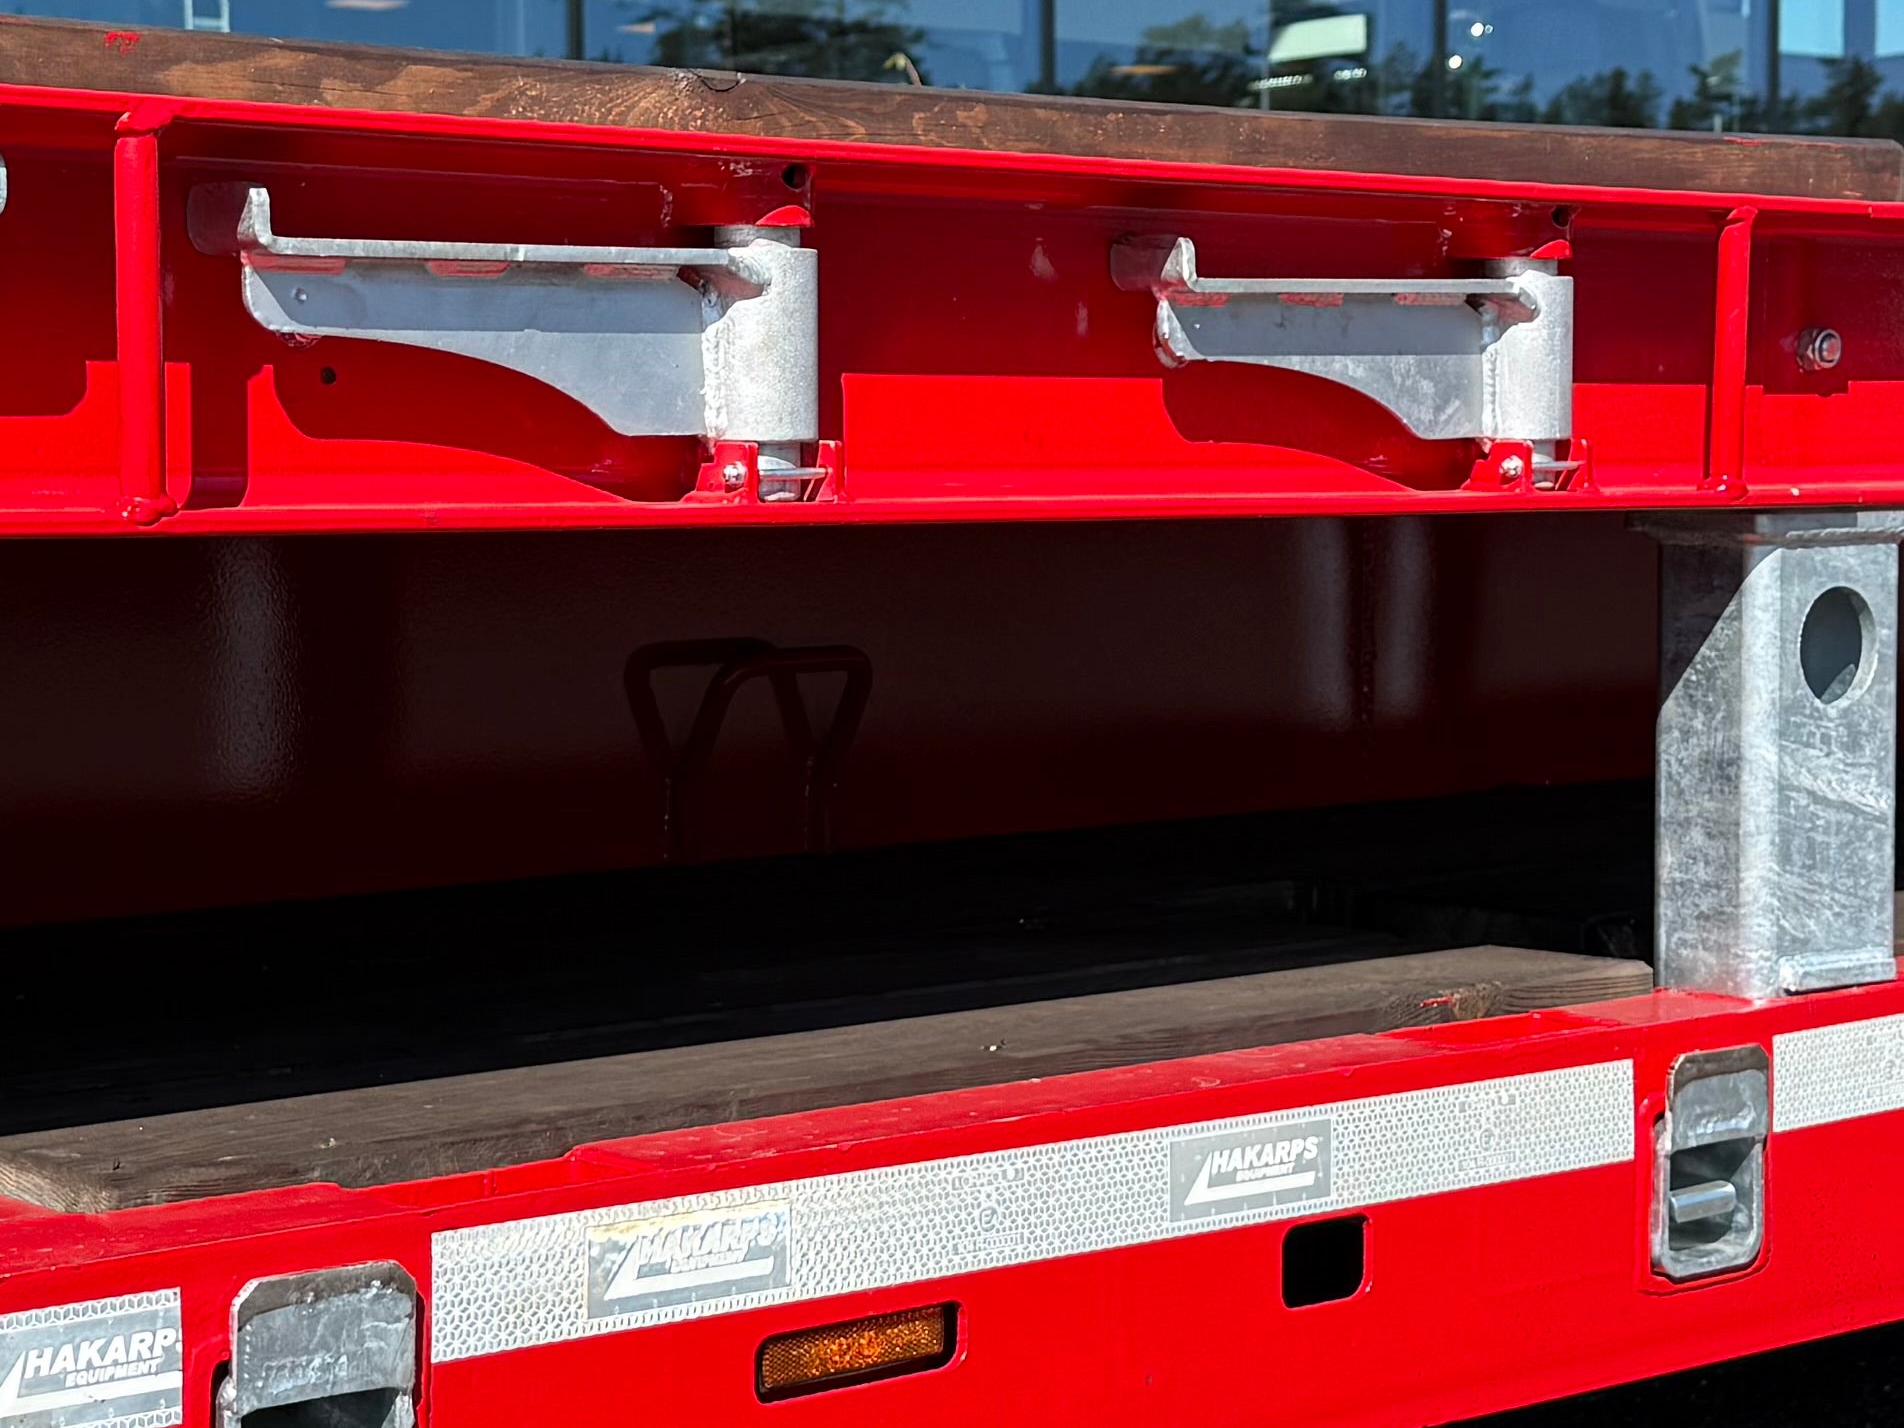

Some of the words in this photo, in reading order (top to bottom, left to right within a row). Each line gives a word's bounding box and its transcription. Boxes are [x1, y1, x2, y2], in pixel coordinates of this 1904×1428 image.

[1211, 1136, 1319, 1175] HAKARPS
[23, 1327, 182, 1379] HAKARP
[65, 1359, 162, 1388] EQUIPMENT
